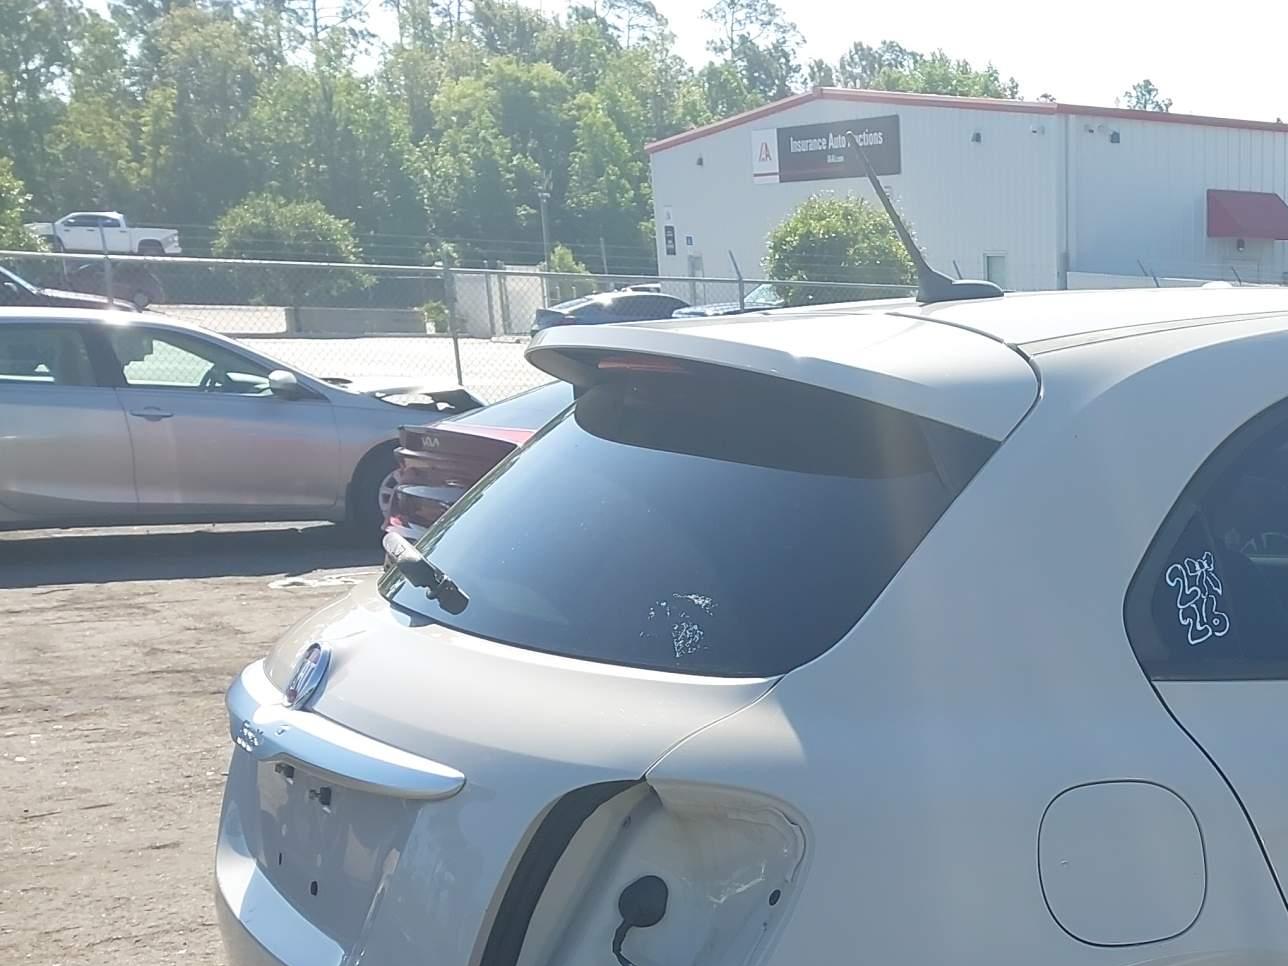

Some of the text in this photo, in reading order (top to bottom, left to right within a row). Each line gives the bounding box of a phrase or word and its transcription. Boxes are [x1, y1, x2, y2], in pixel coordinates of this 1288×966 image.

[790, 127, 883, 152] Insurance Auto ctions
